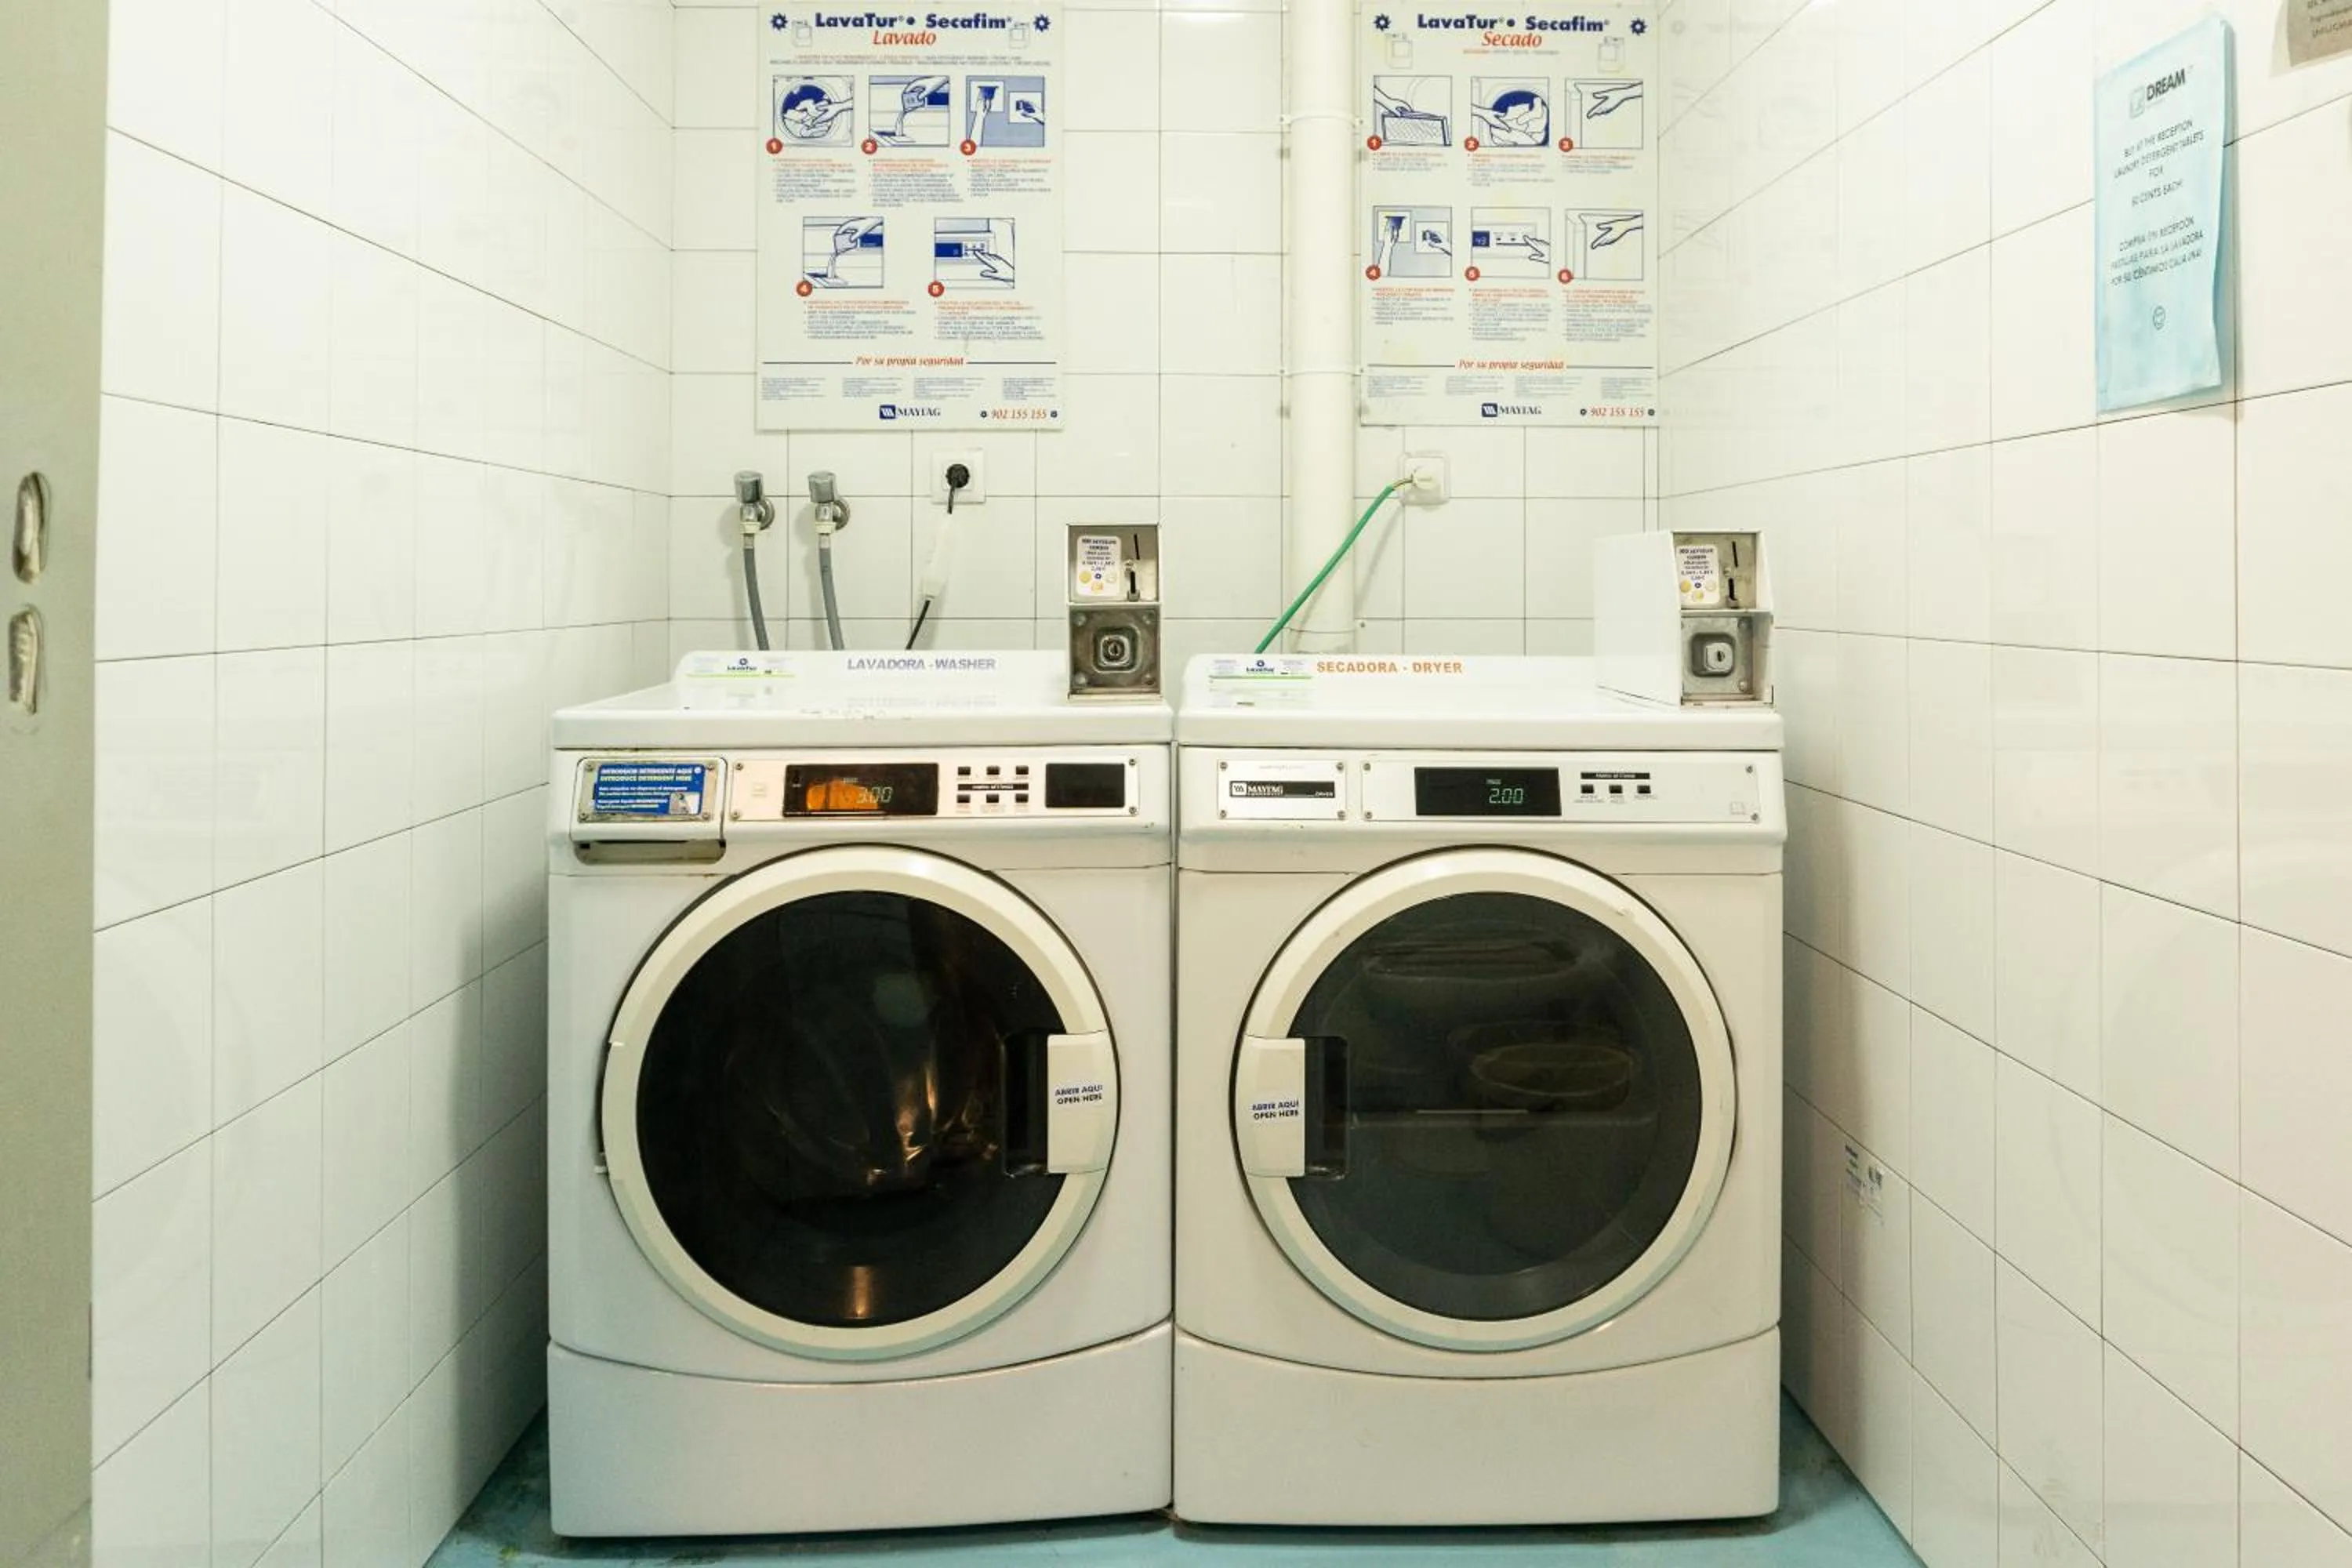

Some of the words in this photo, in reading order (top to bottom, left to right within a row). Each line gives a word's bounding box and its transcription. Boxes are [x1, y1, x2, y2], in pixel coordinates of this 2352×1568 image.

[873, 30, 937, 45] Lavado
[1481, 31, 1543, 48] Secado
[2146, 68, 2187, 101] DREAM
[2157, 119, 2193, 141] RECEPTION
[855, 357, 873, 366] Por
[887, 358, 916, 367] propia
[919, 357, 964, 367] seguridad
[1458, 360, 1474, 368] Por
[1489, 361, 1518, 370] propia
[1520, 360, 1565, 371] seguridad
[897, 407, 941, 417] MAYTAG
[991, 409, 1007, 419] 902
[1500, 405, 1542, 416] MAYTAG
[1590, 407, 1607, 417] 902
[847, 659, 925, 670] LAVADORA
[935, 659, 996, 670] WASHER
[1316, 661, 1398, 674] SECADORA
[1412, 662, 1464, 674] DRYER
[1247, 785, 1283, 795] MAYTAG
[1489, 788, 1523, 804] 2.00
[1056, 1096, 1080, 1105] OPEN
[1082, 1093, 1103, 1102] HERE
[1254, 1110, 1276, 1120] OPEN
